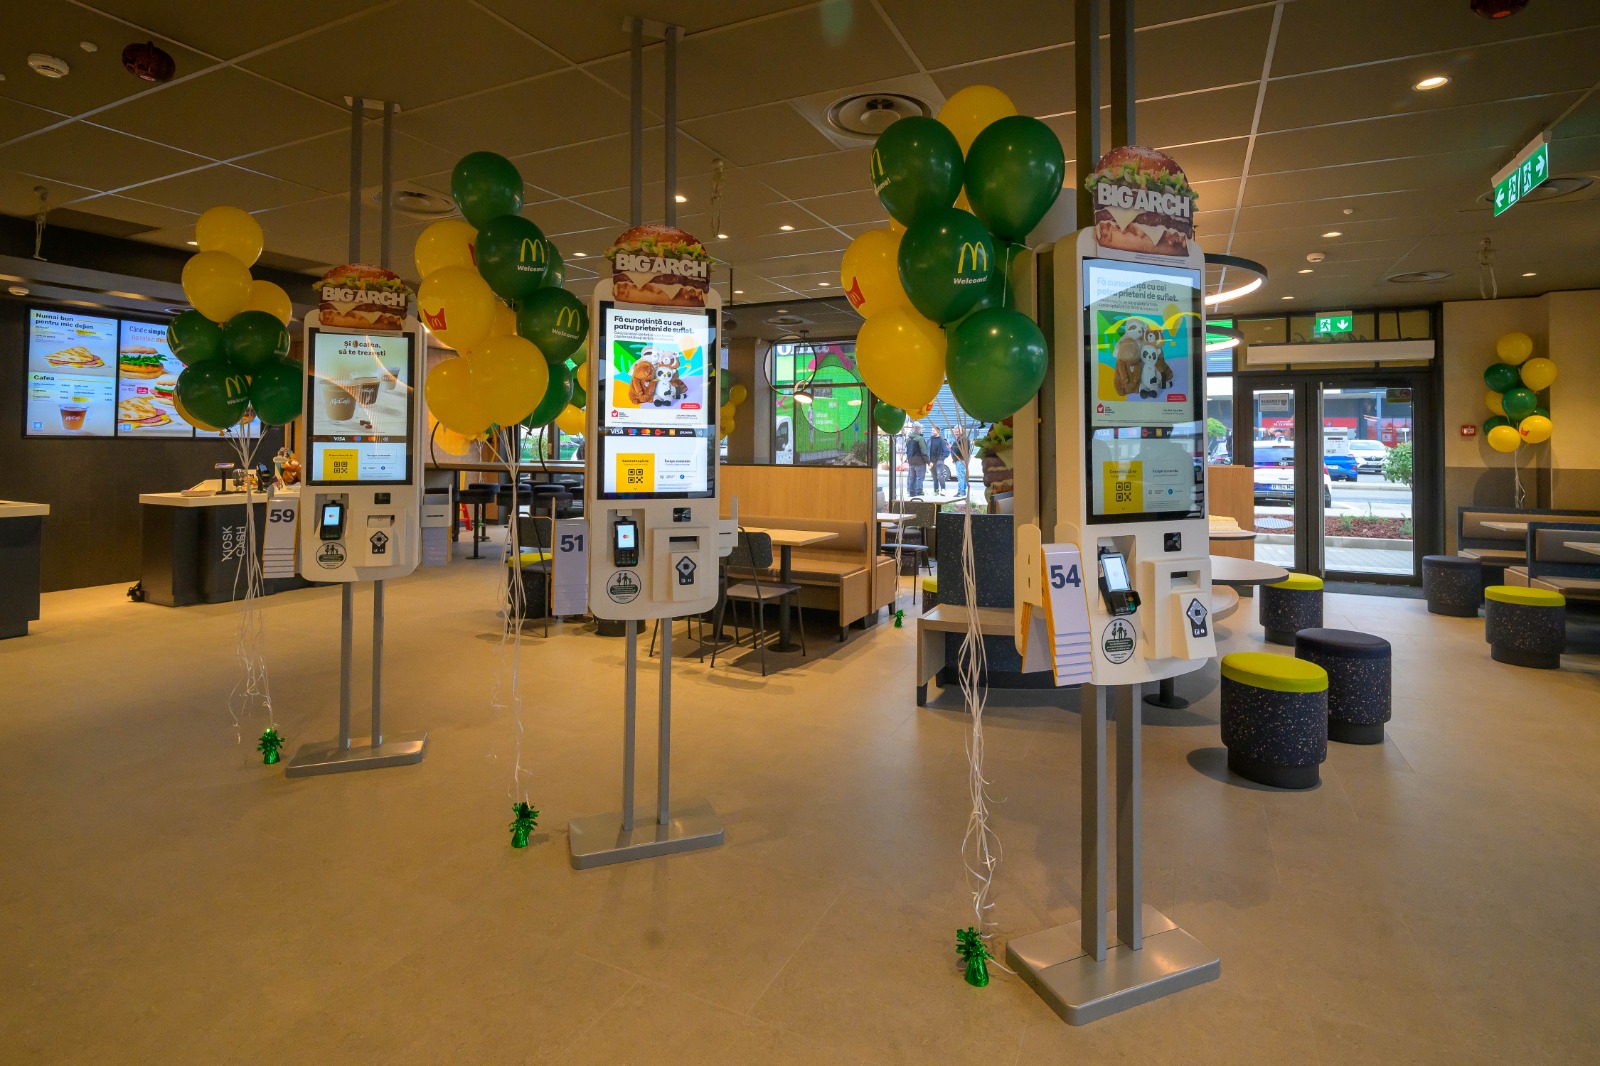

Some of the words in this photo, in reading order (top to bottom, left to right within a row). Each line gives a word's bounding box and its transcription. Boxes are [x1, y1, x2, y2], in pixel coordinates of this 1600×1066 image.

[1097, 182, 1133, 209] BIG
[1134, 189, 1190, 217] ARCH
[615, 253, 651, 272] BIG
[652, 257, 707, 277] ARCH
[953, 275, 988, 285] Welcome!
[1156, 283, 1167, 291] cei
[322, 287, 354, 302] BIG
[353, 290, 406, 307] ARCH
[1118, 289, 1146, 299] prieteni
[1146, 292, 1156, 300] de
[1156, 294, 1179, 302] suflet.
[35, 312, 59, 320] Numai
[624, 317, 663, 326] cunoștință
[551, 328, 580, 340] Welcome!
[269, 508, 295, 523] 59
[222, 525, 233, 560] KIOSK
[560, 534, 584, 553] 51
[1050, 564, 1081, 589] 54
